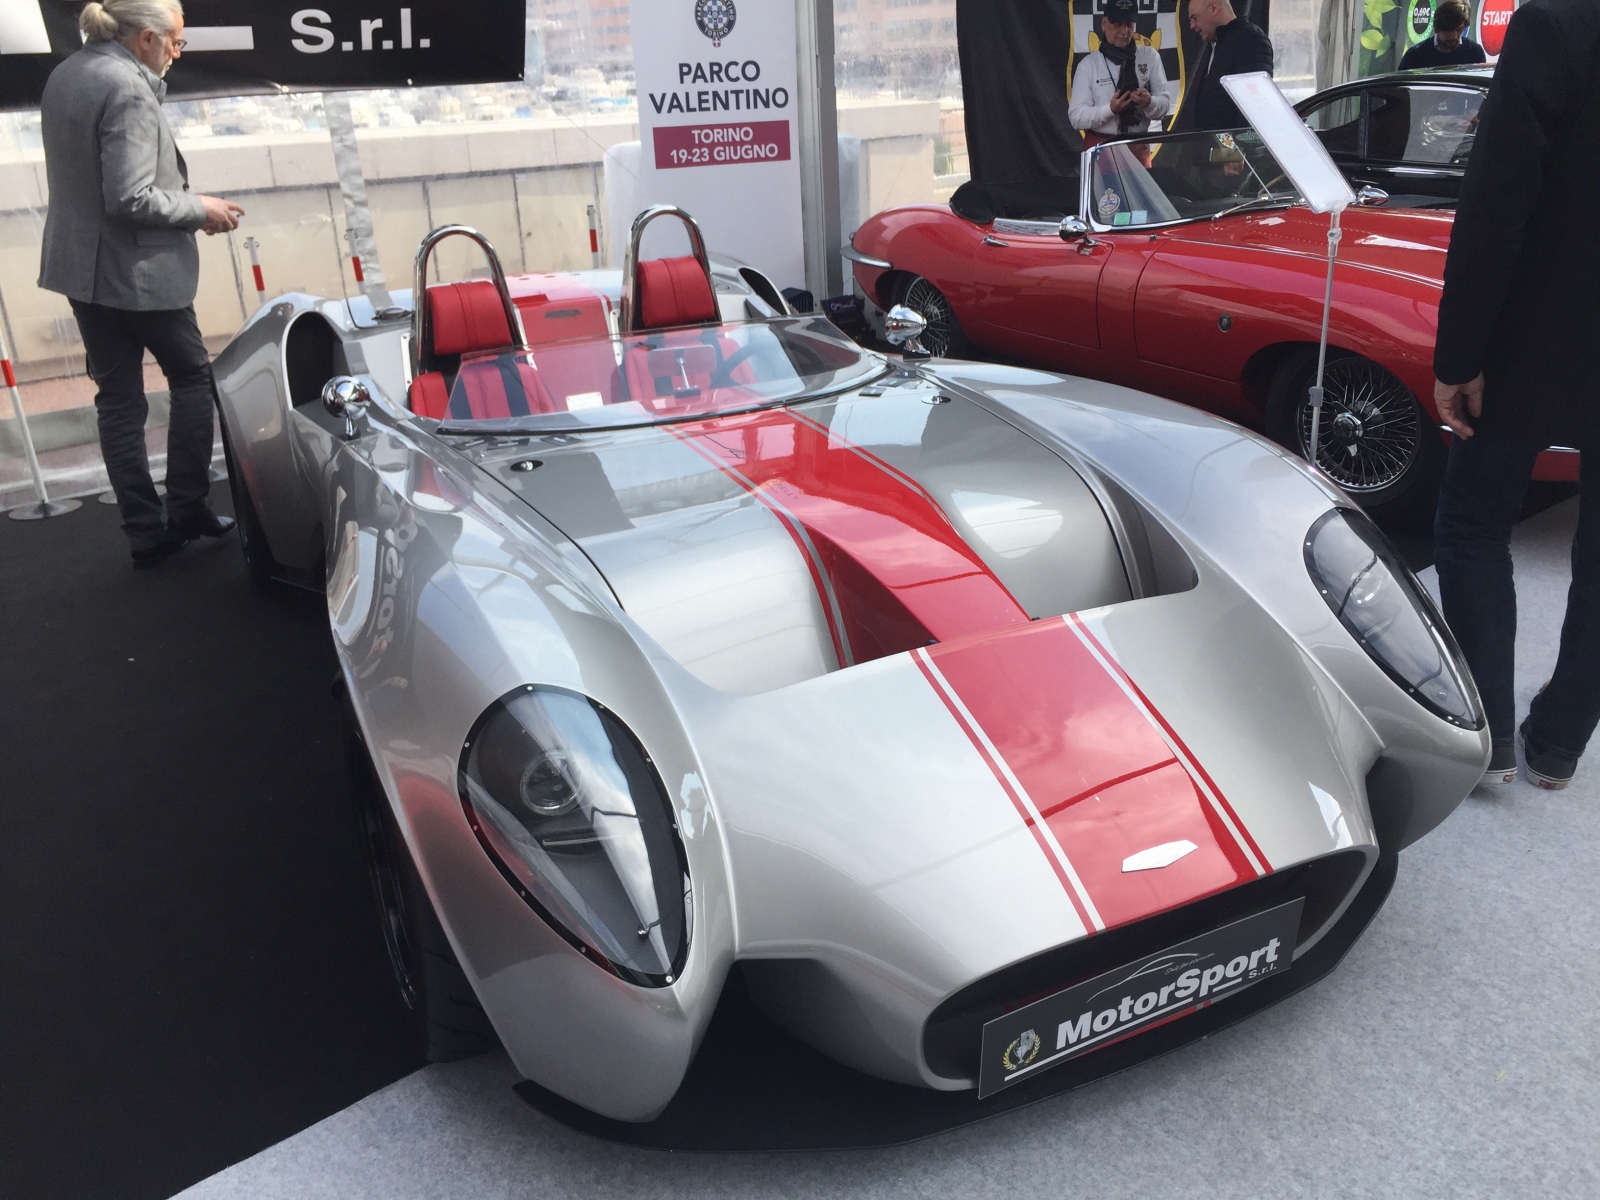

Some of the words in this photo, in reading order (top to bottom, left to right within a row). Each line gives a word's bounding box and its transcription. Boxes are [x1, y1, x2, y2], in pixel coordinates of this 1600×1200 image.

[1483, 10, 1513, 26] START
[290, 7, 431, 53] S.r.l.
[704, 27, 729, 37] TORINO
[678, 60, 761, 84] PARCO
[648, 87, 789, 114] VALENTINO
[691, 126, 754, 144] TORINO
[670, 147, 710, 164] 19-23
[713, 143, 778, 161] GIUGNO
[1248, 962, 1277, 979] S.r.l.
[1056, 937, 1281, 1050] MotorSport
